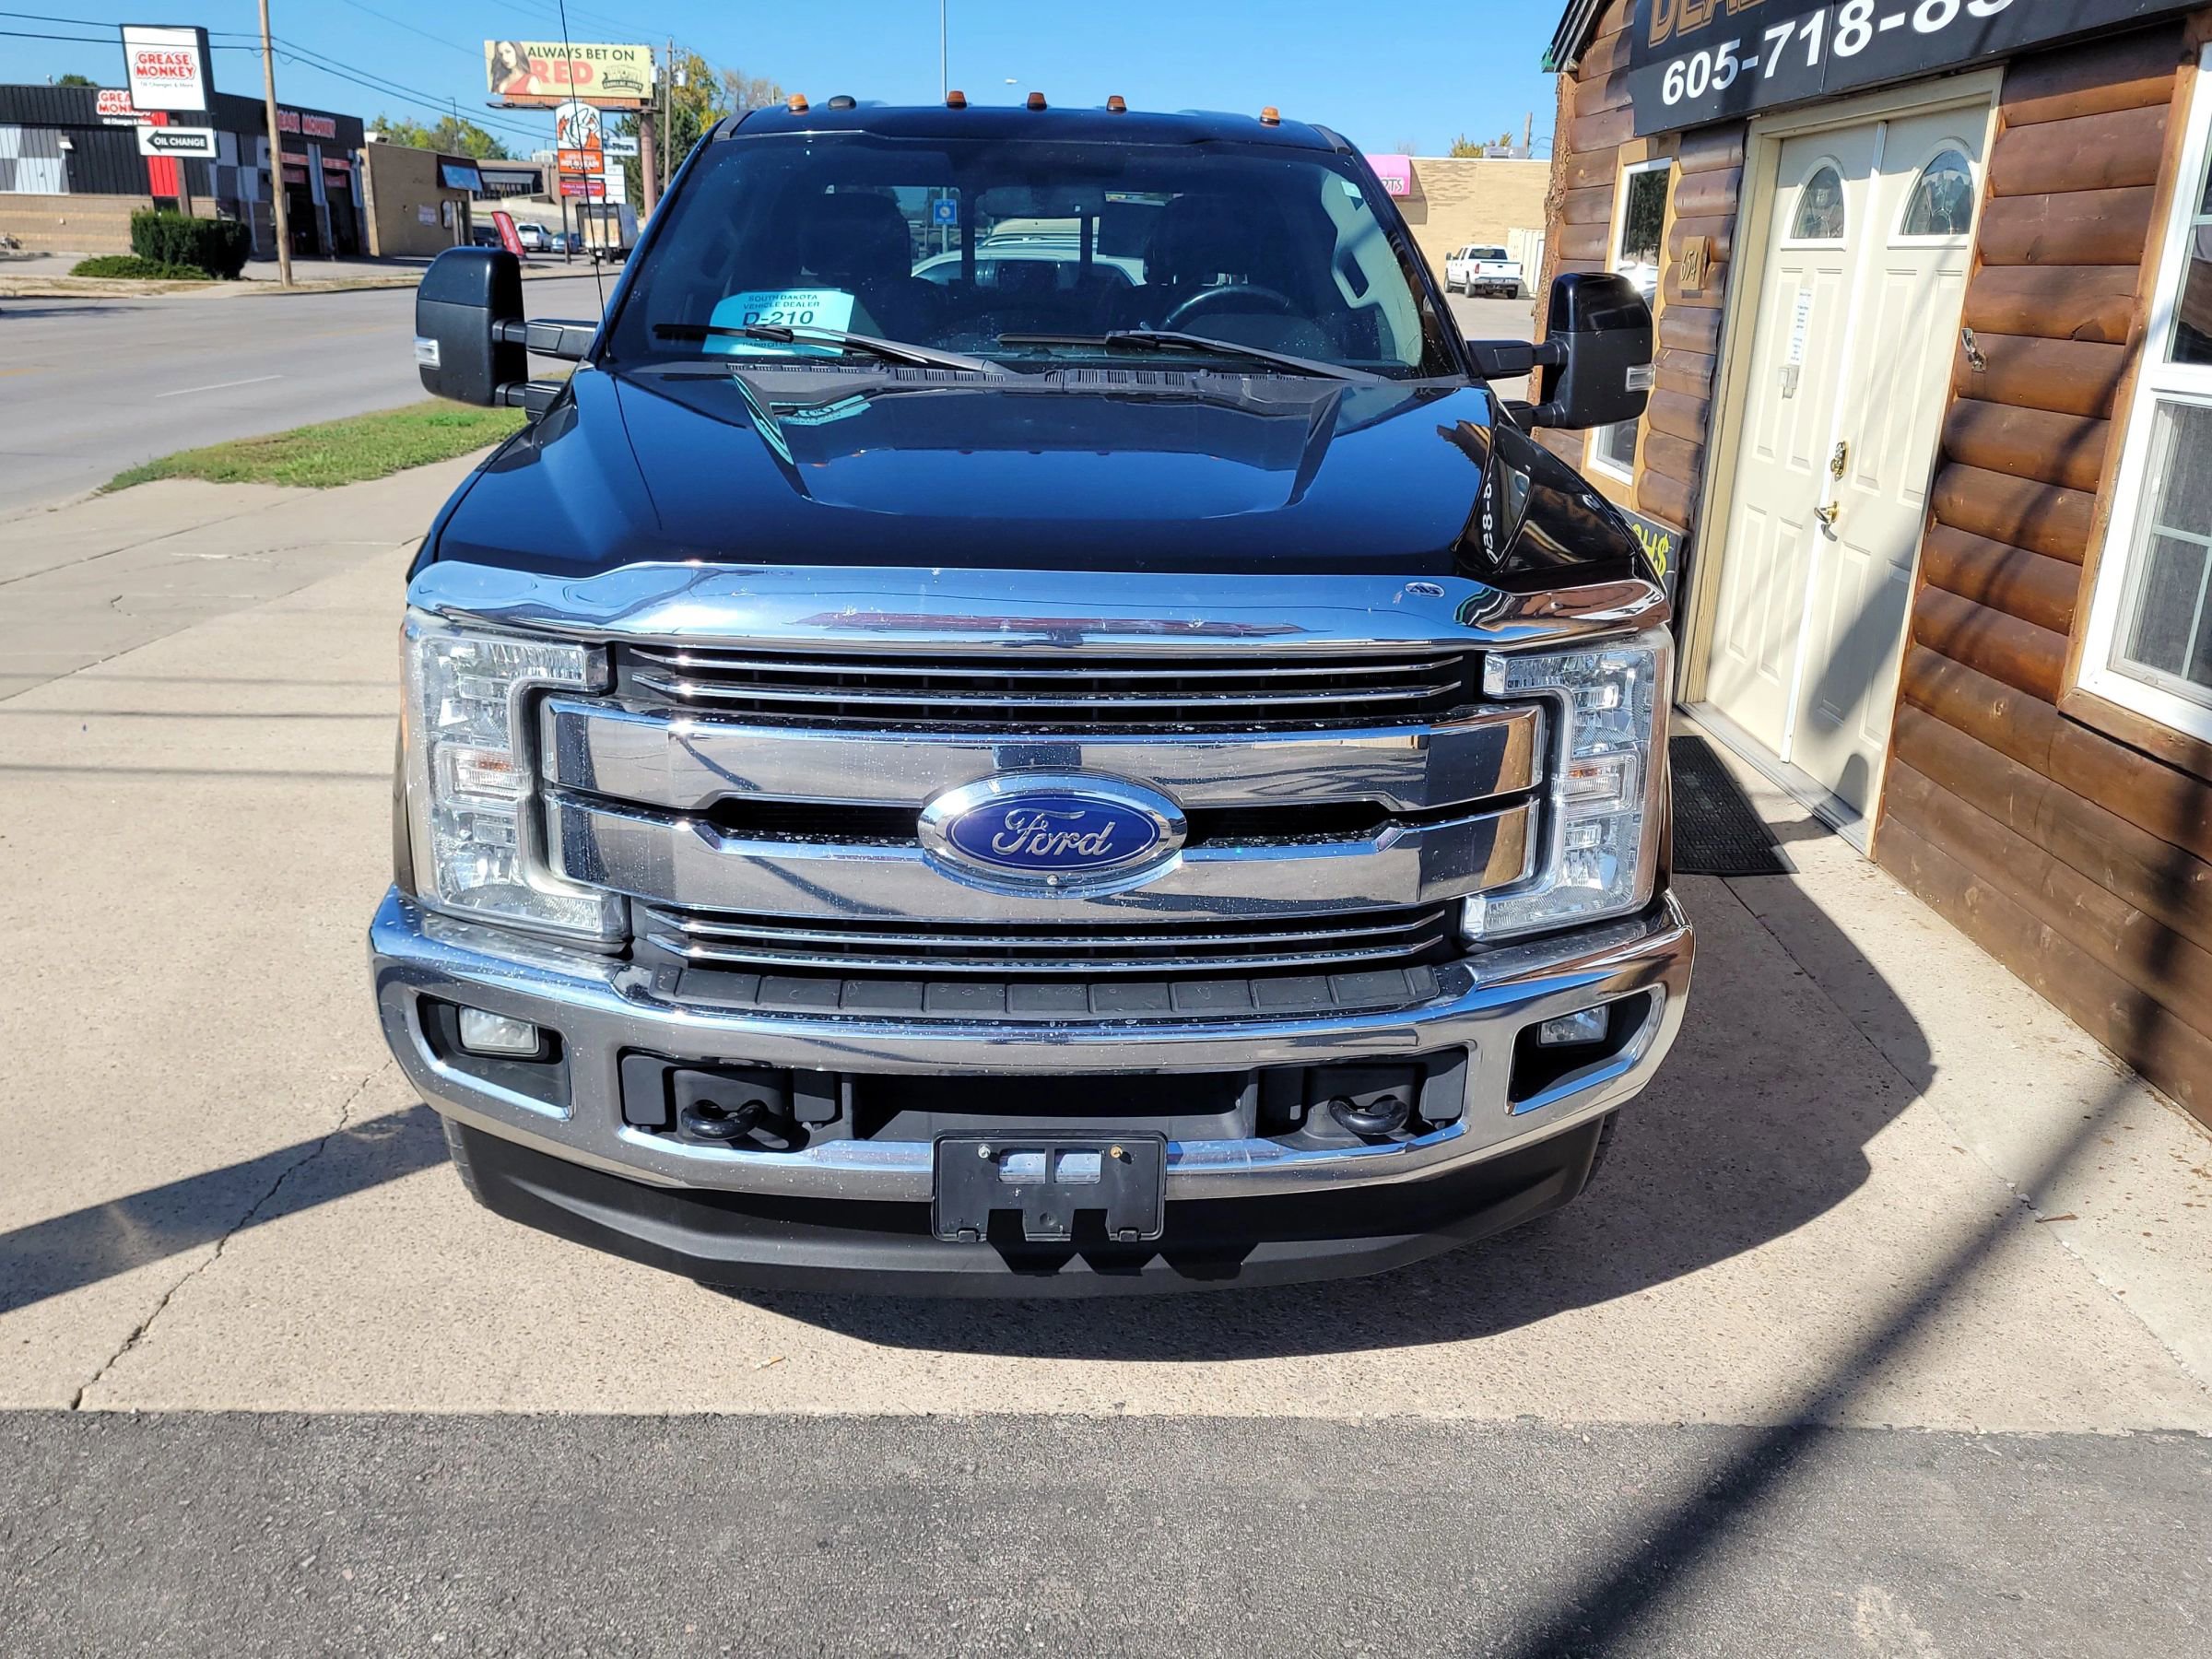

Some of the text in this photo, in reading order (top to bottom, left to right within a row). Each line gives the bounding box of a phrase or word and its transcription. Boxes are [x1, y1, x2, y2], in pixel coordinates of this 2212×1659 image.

[138, 54, 189, 65] GREASE
[528, 47, 634, 61] ALWAYS BET ON
[135, 65, 194, 77] MONKEY
[530, 60, 594, 85] RED
[100, 92, 130, 102] GREA
[154, 136, 206, 147] OIL CHANGE
[1680, 250, 1699, 282] 654
[744, 301, 782, 310] VEHICLE
[742, 311, 814, 326] D-210
[991, 807, 1116, 857] Ford
